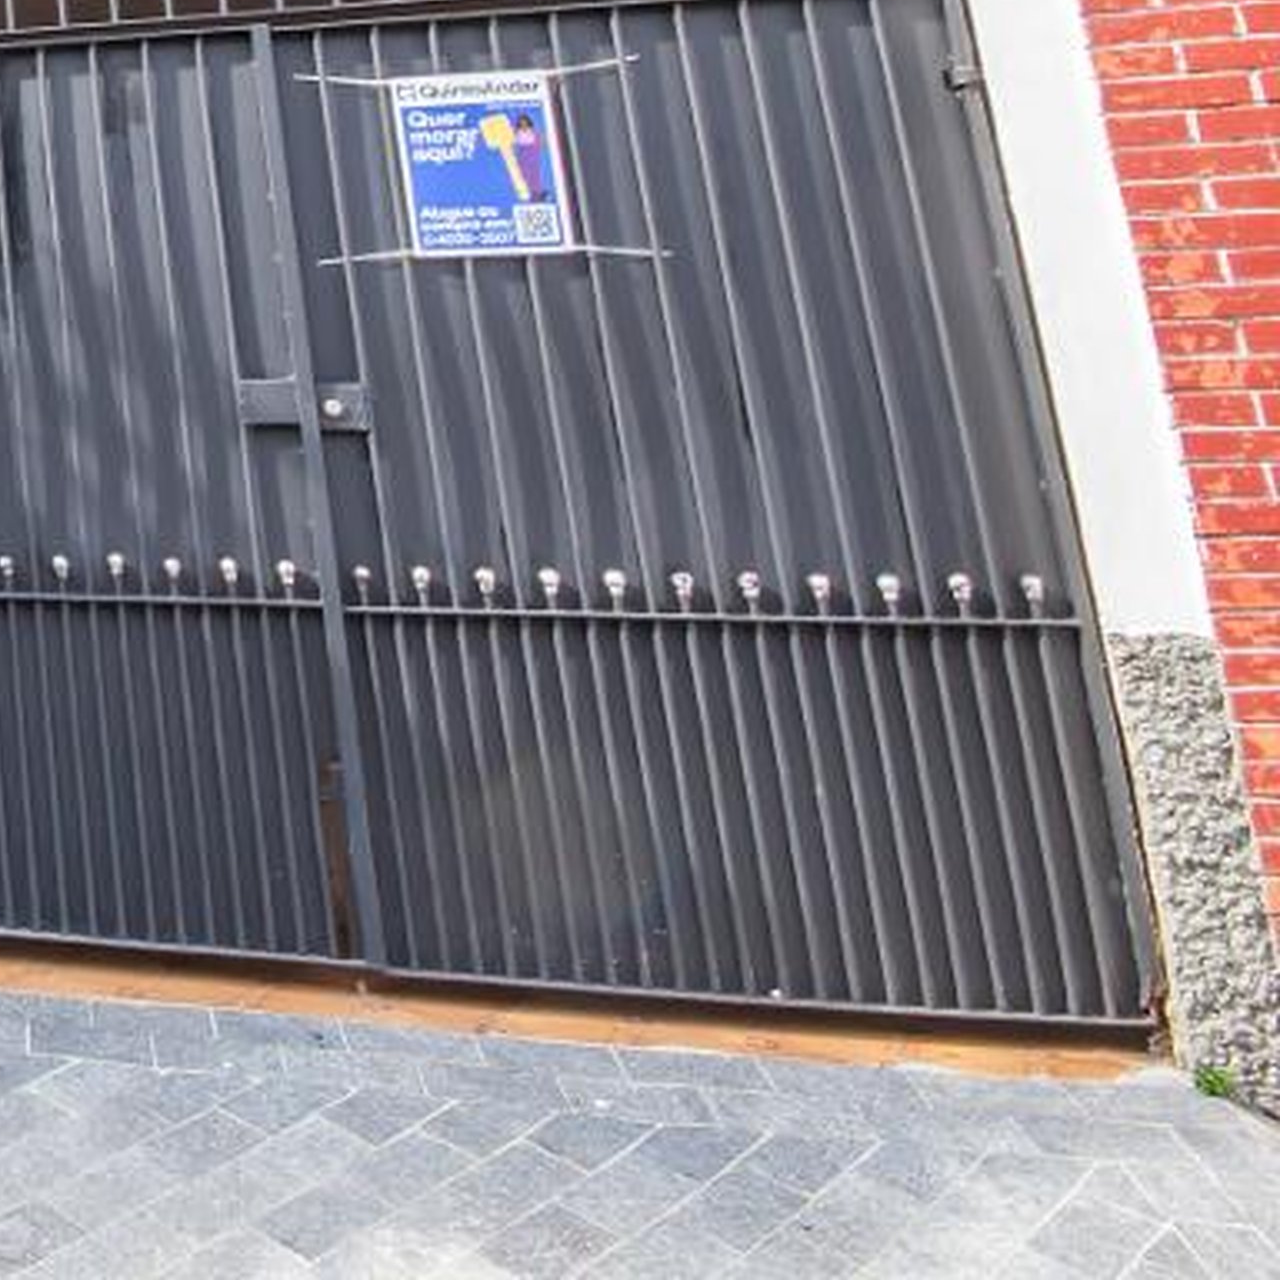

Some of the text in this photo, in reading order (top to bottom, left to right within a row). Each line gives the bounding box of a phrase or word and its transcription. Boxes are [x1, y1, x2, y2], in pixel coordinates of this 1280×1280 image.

[407, 110, 467, 128] Quer
[409, 128, 477, 146] morar
[413, 142, 475, 164] aqui?
